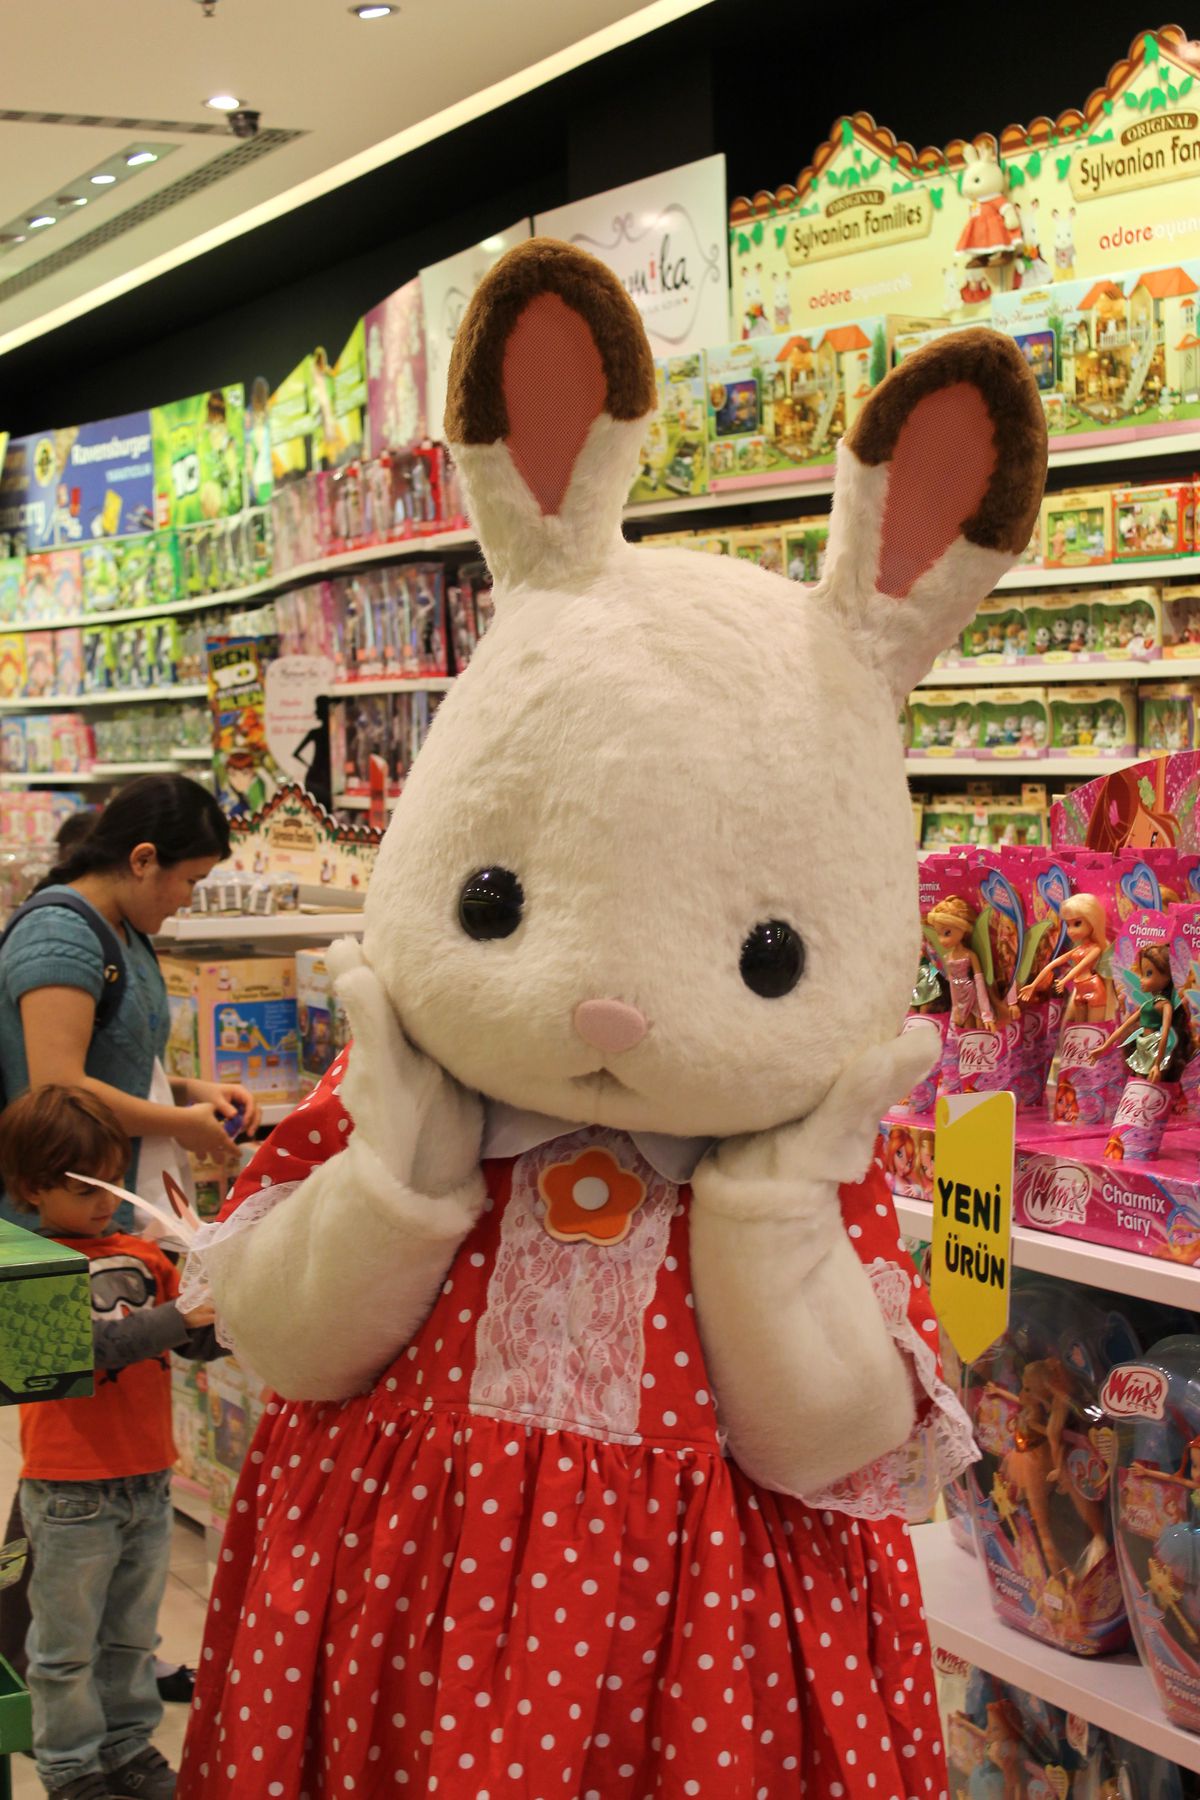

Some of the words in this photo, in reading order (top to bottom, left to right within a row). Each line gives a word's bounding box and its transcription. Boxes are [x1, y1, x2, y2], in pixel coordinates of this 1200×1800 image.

[1126, 115, 1193, 142] ORIGINAL
[1080, 148, 1165, 192] Sylvanian
[829, 192, 882, 213] ORIGINAL
[794, 220, 861, 258] Sylvanian
[864, 203, 922, 236] Families
[1129, 923, 1168, 937] Charmix
[937, 1177, 1001, 1234] YENİ
[1102, 1183, 1167, 1215] Charmix
[1116, 1210, 1151, 1237] Fairy
[945, 1232, 1005, 1289] ÜRÜN
